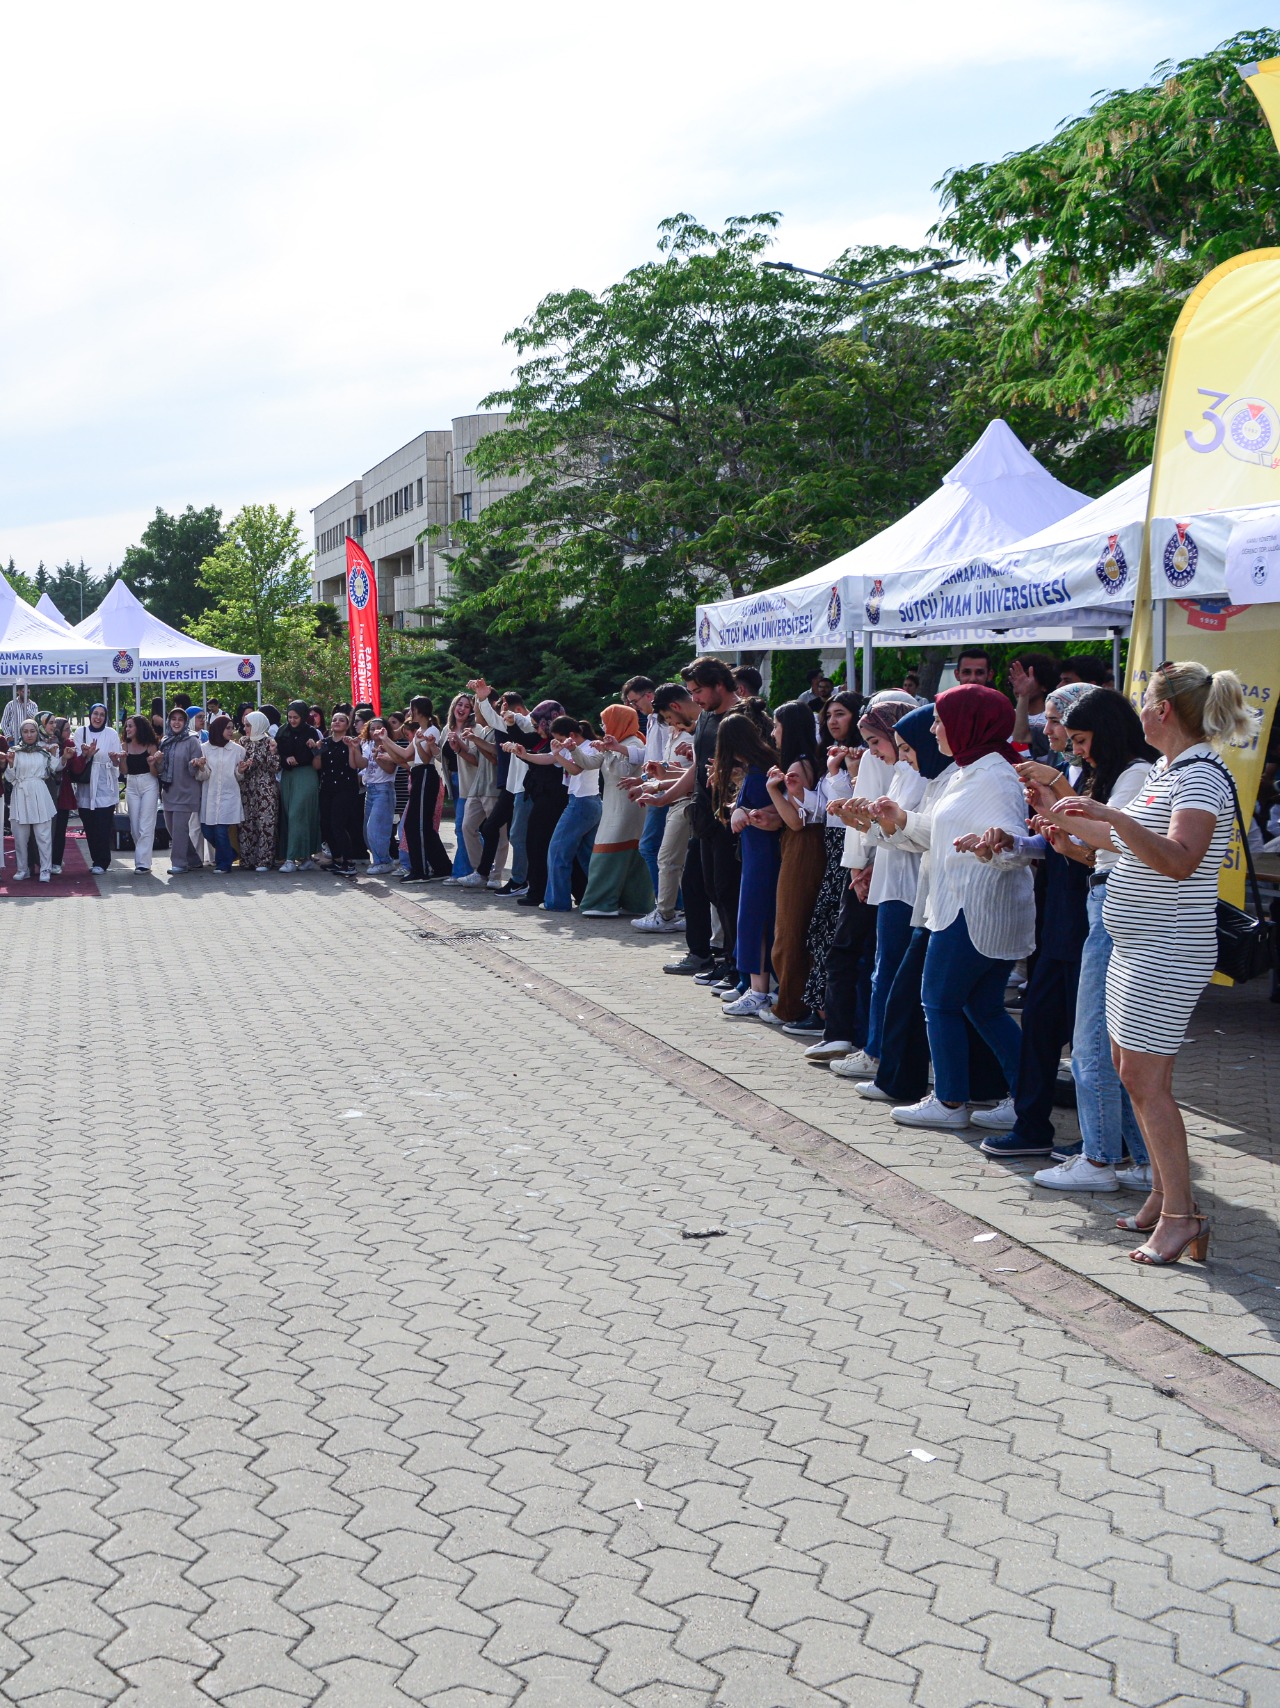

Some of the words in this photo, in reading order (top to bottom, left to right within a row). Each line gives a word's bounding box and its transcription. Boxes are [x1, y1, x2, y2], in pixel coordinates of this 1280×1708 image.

[899, 592, 938, 626] SÜTÇÜ
[940, 591, 971, 619] İMAM
[976, 572, 1072, 615] ÜNİVERSİTESİ
[761, 608, 813, 639] ÜNİVERSİTESİ
[1200, 617, 1218, 626] 1992
[0, 661, 88, 676] ÜNİVERSİTESİ
[142, 668, 218, 680] ÜNİVERSİTESİ
